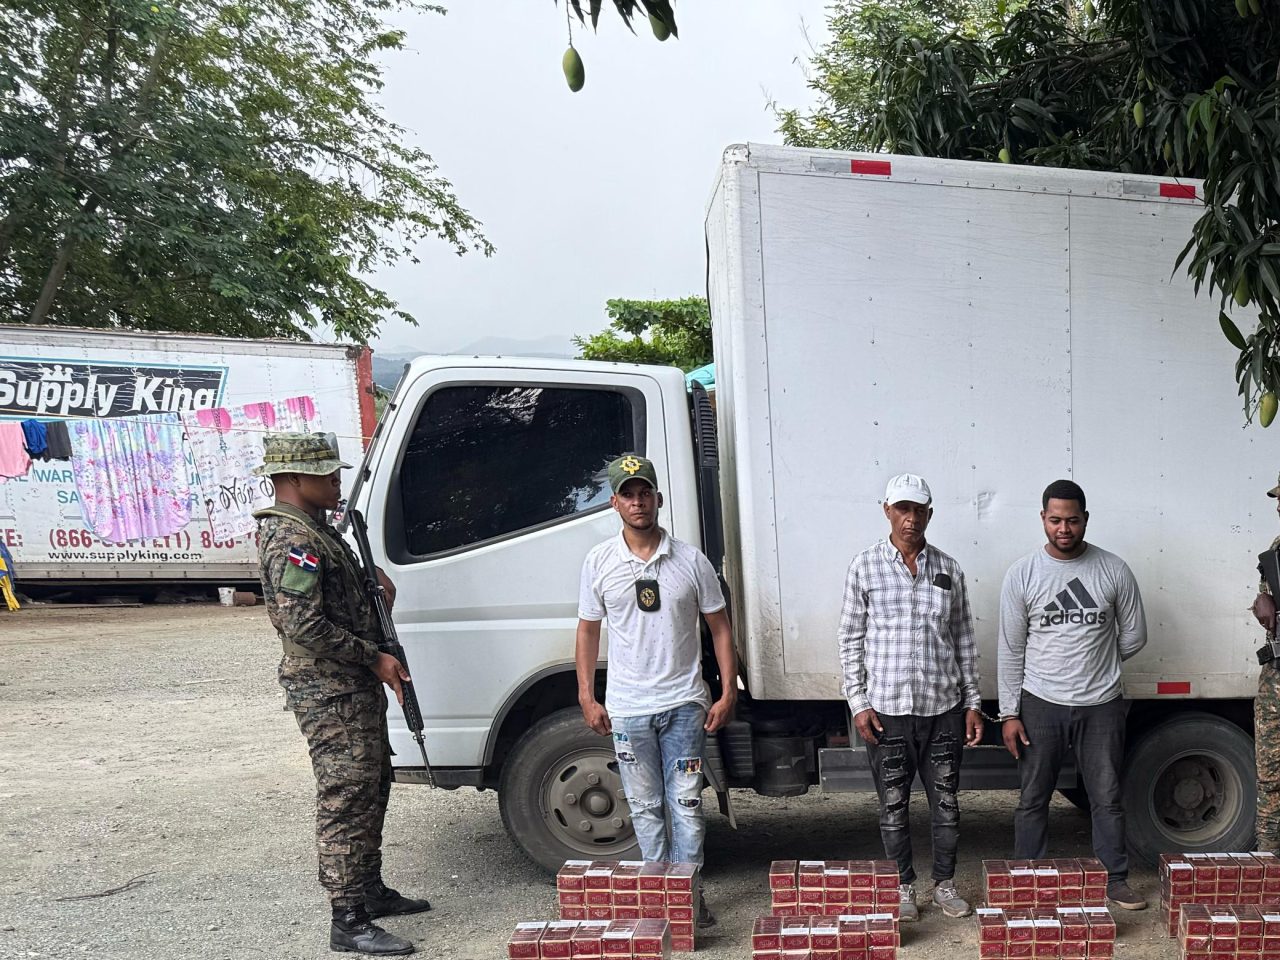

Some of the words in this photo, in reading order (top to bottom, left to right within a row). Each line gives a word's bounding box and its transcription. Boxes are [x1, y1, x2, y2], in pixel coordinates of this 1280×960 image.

[0, 370, 118, 417] Supply
[48, 550, 202, 562] www.supplyking.com
[1040, 608, 1107, 627] adidas
